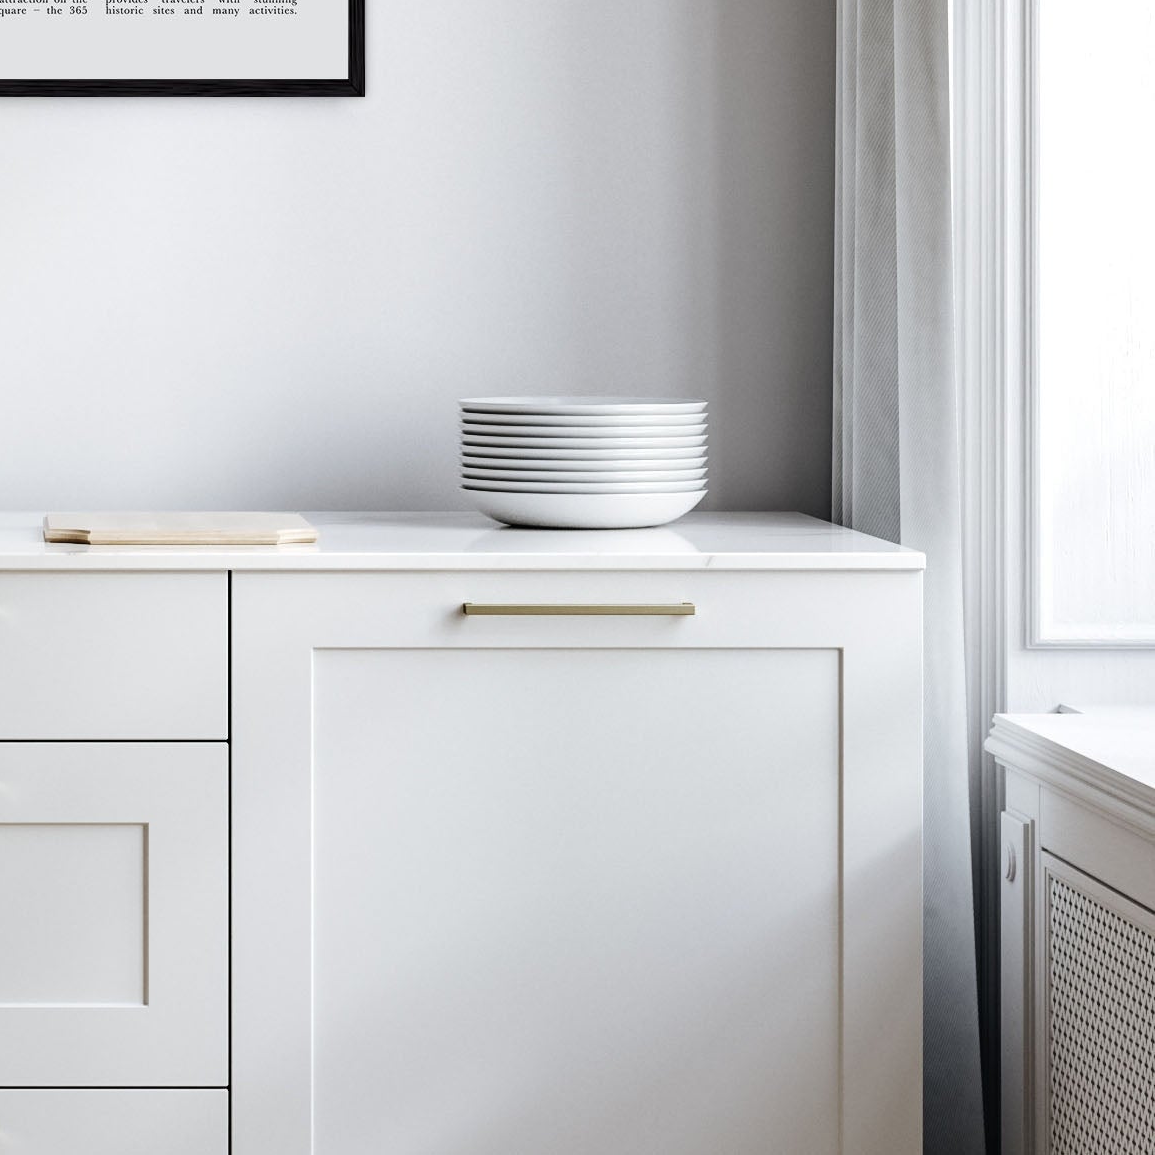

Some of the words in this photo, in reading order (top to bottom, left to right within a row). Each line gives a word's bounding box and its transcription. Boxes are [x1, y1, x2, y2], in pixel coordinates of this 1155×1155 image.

[106, 6, 144, 15] historic
[153, 6, 175, 15] sites
[184, 6, 203, 15] and
[213, 8, 240, 18] many
[249, 6, 297, 15] activities.
